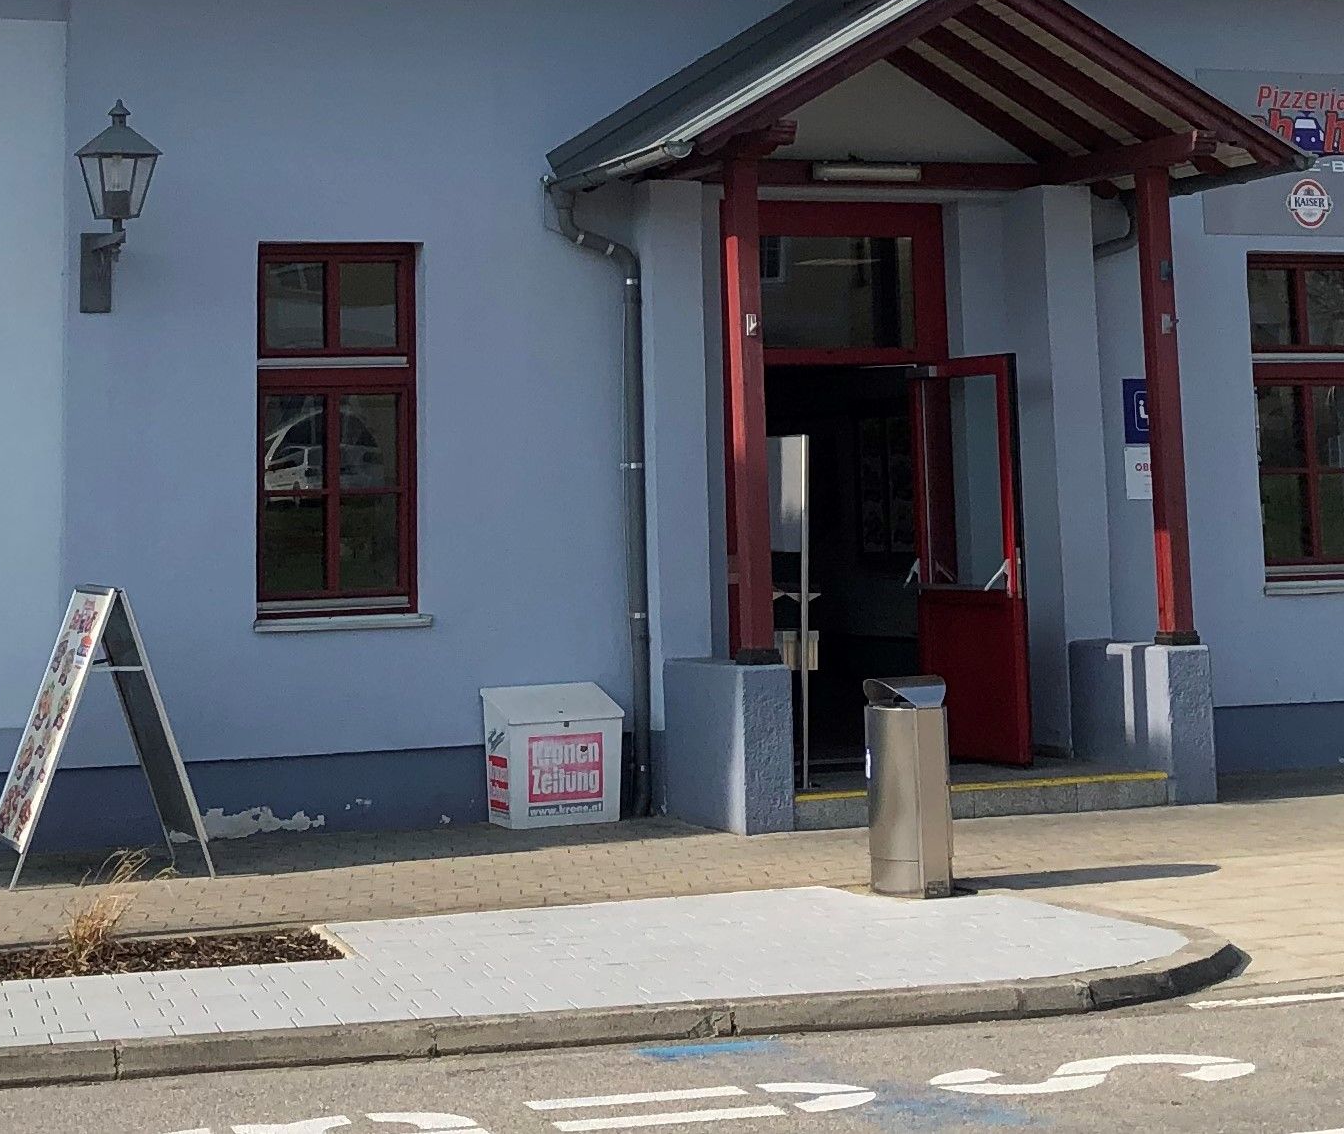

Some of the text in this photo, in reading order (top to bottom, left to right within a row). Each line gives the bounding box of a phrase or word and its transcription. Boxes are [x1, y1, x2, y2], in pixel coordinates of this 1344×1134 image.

[1294, 196, 1326, 208] KAISER
[532, 740, 600, 766] Kronen
[532, 766, 600, 795] Zeitung
